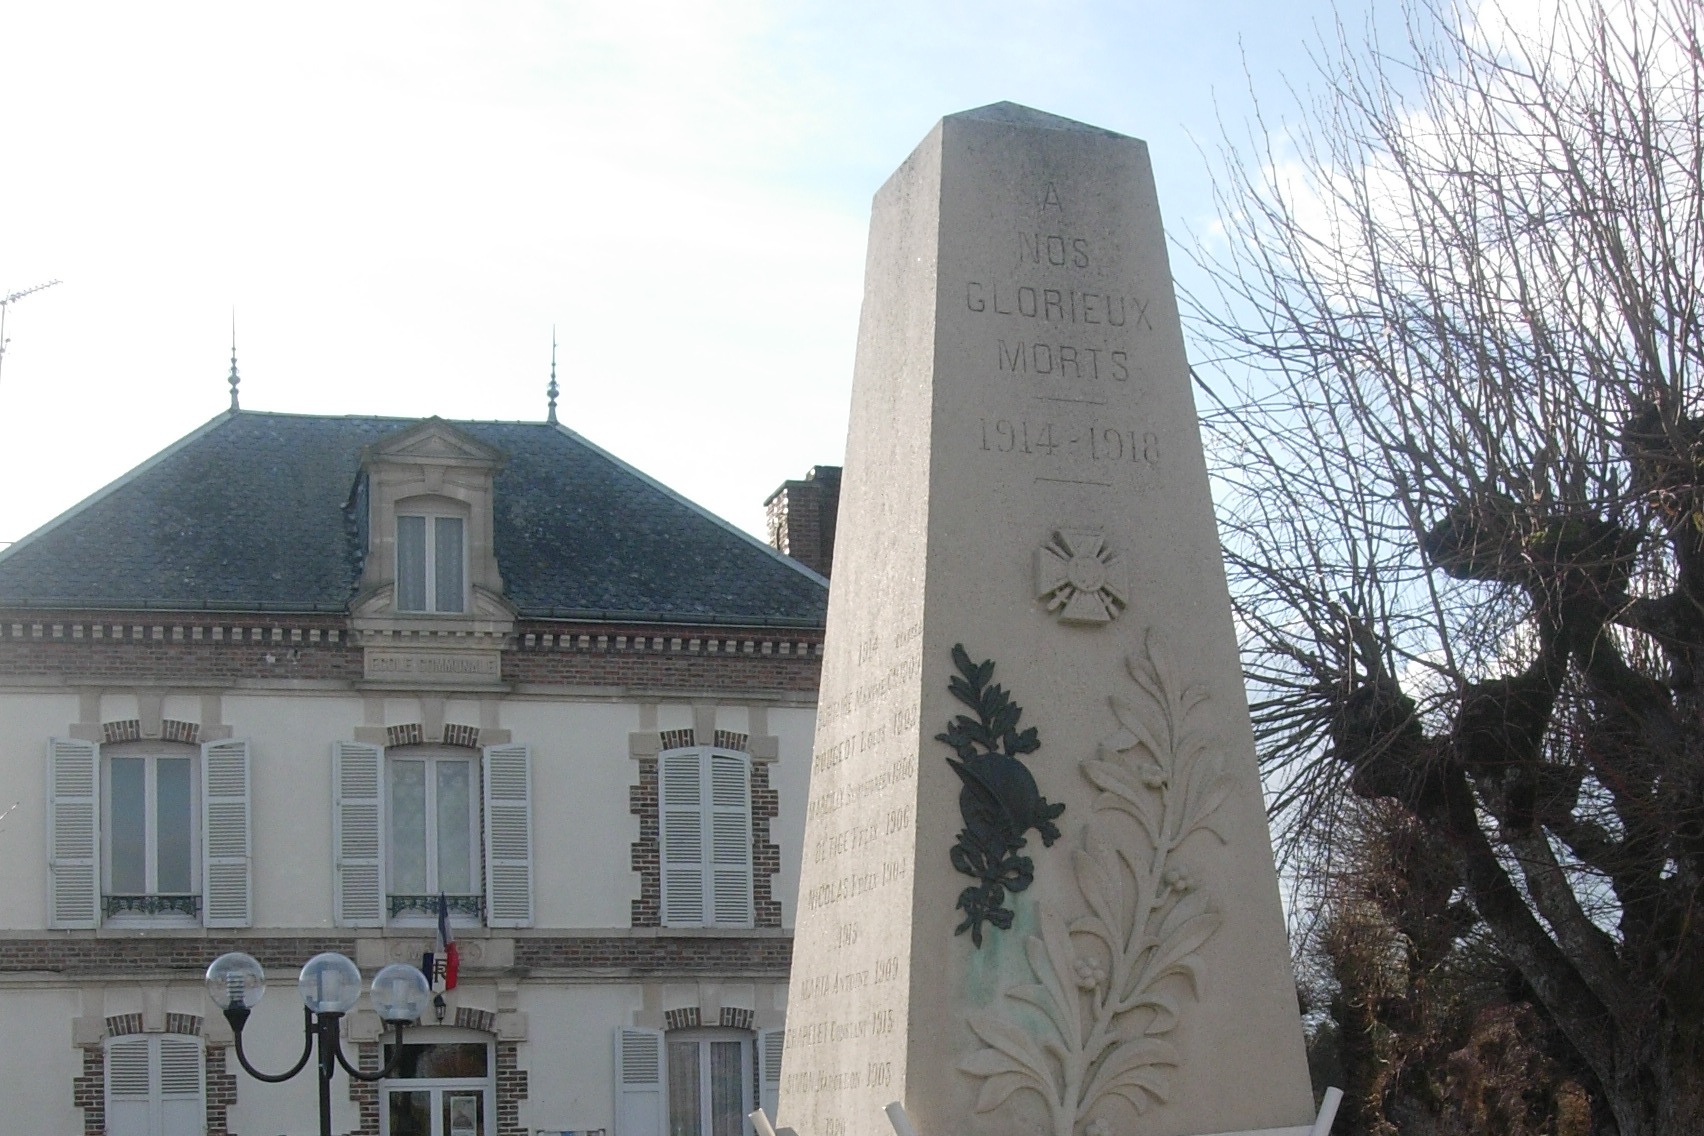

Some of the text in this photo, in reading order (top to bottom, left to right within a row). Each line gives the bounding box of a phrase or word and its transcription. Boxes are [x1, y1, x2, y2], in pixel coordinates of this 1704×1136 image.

[1043, 181, 1063, 213] A
[1018, 231, 1090, 269] NOS
[966, 281, 1153, 332] GLORIEUX
[997, 338, 1129, 382] MORTS
[886, 804, 910, 836] 1906
